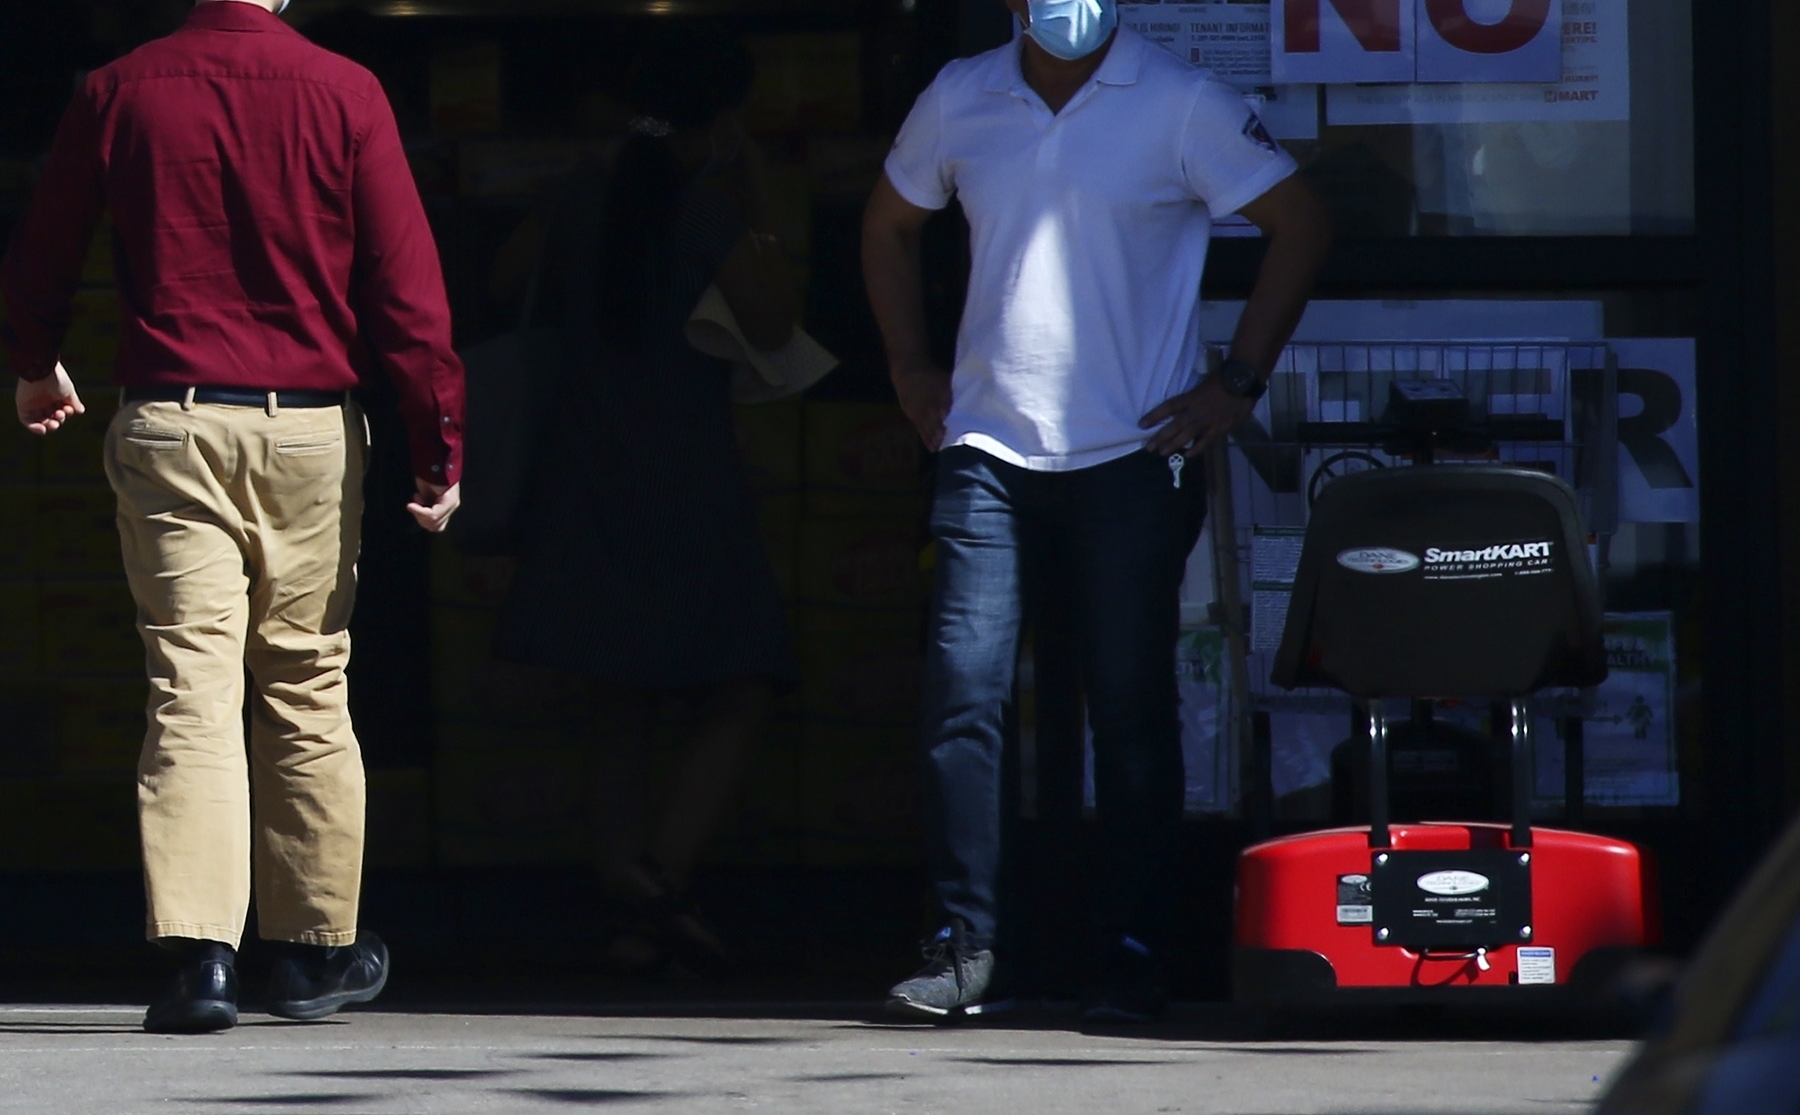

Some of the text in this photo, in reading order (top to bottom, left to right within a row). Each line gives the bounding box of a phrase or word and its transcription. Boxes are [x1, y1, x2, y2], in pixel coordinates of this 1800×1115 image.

[1190, 22, 1223, 33] TENANT
[1226, 23, 1271, 33] INFORMAT
[1562, 22, 1597, 35] ERE!
[1558, 90, 1599, 101] MART
[1424, 542, 1550, 563] SmartKART
[1606, 652, 1657, 667] ALTHY
